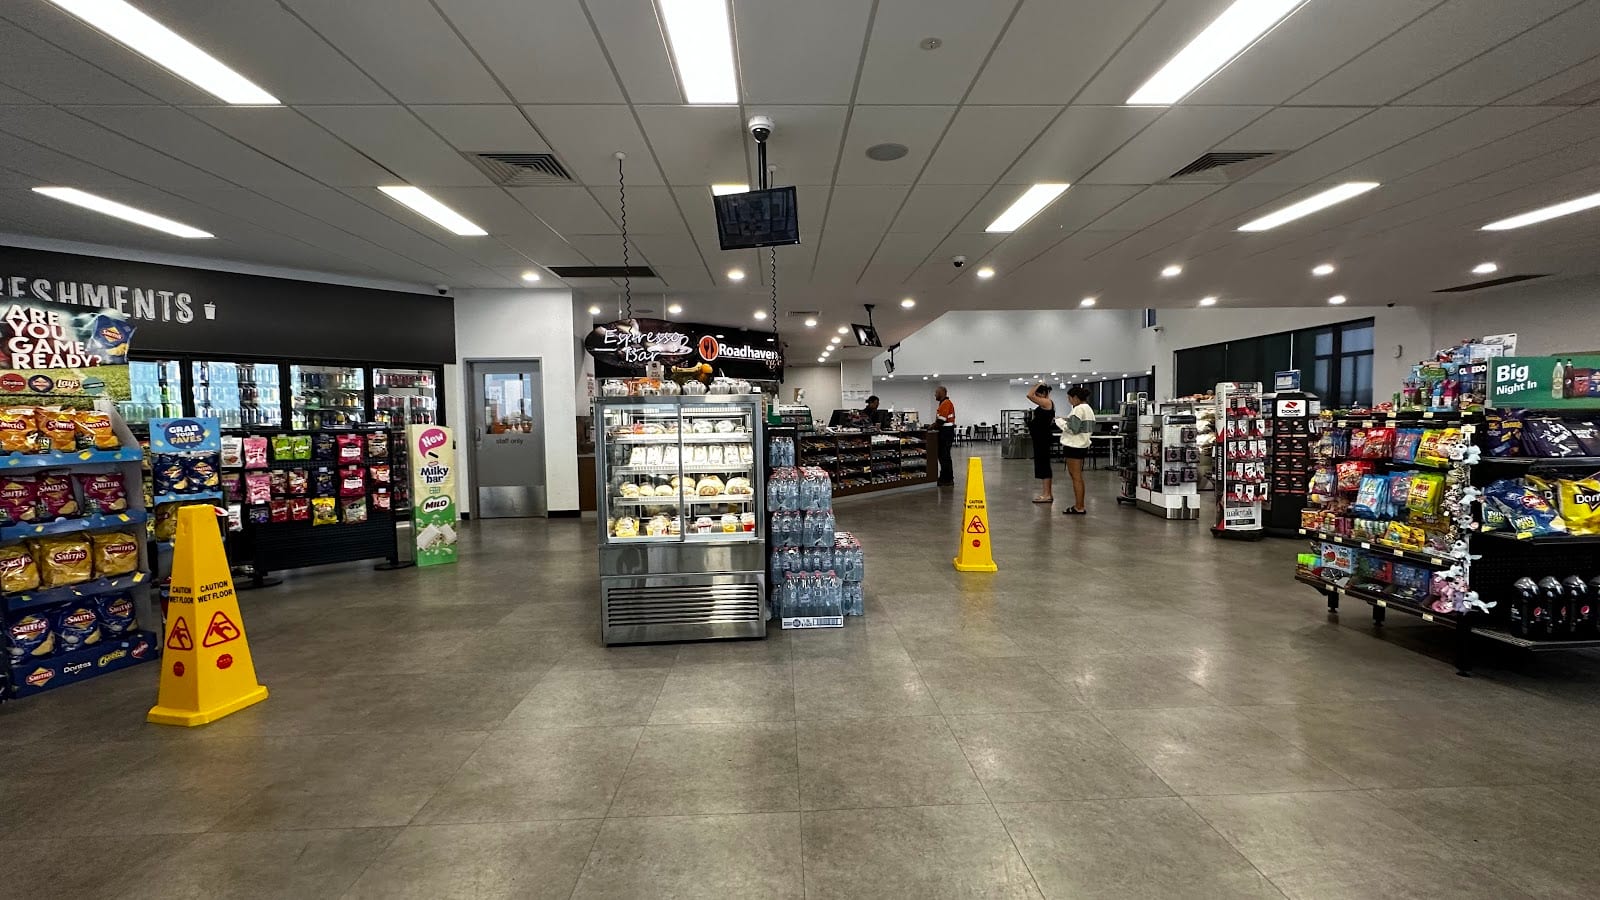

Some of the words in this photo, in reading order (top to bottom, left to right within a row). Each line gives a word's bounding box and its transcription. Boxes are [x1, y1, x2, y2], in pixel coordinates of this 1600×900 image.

[6, 304, 58, 326] ARE
[7, 319, 66, 341] YOU
[604, 329, 686, 347] Espresso
[8, 336, 85, 356] GAME
[718, 343, 777, 361] Roadhaven
[12, 352, 102, 370] READY?
[622, 346, 661, 362] Bar
[1496, 363, 1529, 383] Big
[1496, 384, 1524, 395] Night
[1527, 381, 1537, 390] In
[168, 425, 199, 434] GRAB
[170, 435, 202, 445] FAVES
[421, 433, 444, 448] New
[420, 465, 449, 477] Milky
[426, 475, 444, 484] bar
[425, 500, 447, 510] MILO
[171, 586, 192, 594] CAUTION
[200, 580, 229, 593] CAUTION
[169, 595, 181, 604] WET
[179, 596, 194, 605] FLOOR
[197, 592, 212, 604] WET
[212, 588, 233, 601] FLOOR
[63, 661, 92, 674] Doritos
